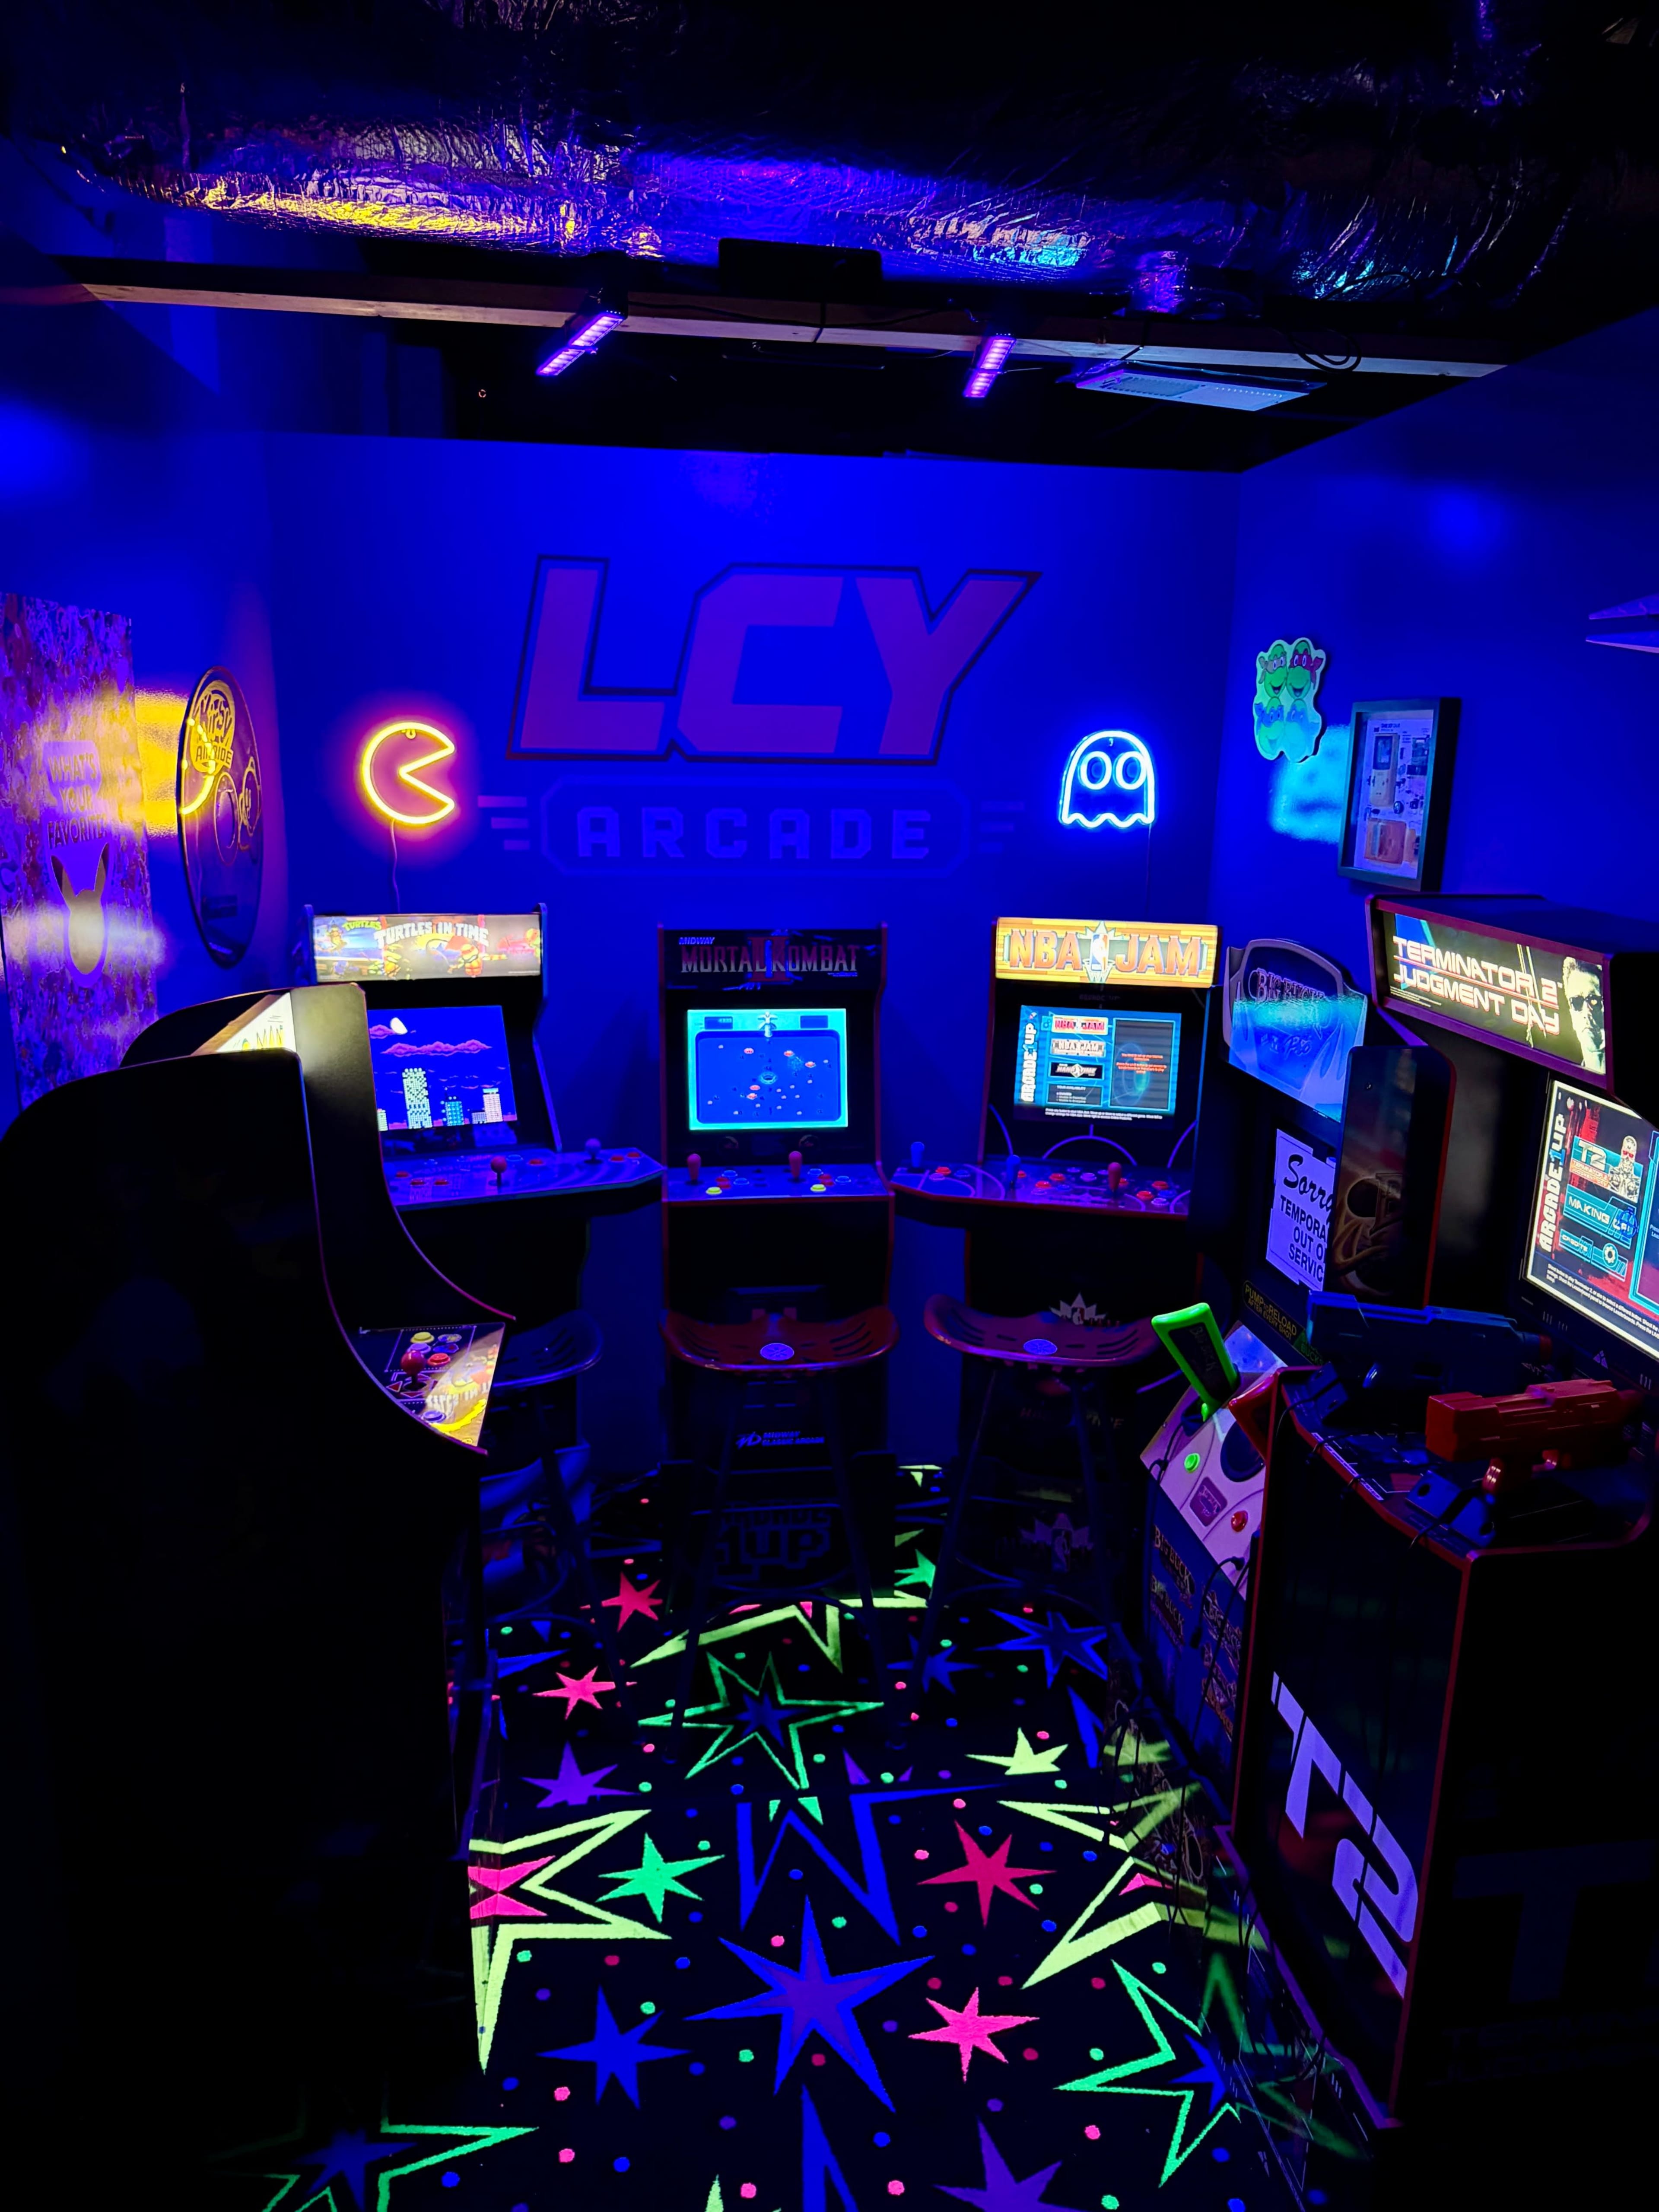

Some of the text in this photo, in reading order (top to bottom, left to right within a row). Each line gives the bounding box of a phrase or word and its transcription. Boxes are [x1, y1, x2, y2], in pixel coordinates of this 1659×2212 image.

[512, 560, 1035, 761] LCY
[48, 753, 97, 783] WHAT'S
[59, 786, 93, 811] YOUR
[47, 813, 107, 850] FAVORITE?
[577, 807, 931, 859] ARCADE
[342, 921, 382, 931] TURTLES
[373, 922, 489, 949] TURTLES IN TIME
[679, 937, 715, 945] MIDWAY
[681, 945, 861, 973] MORTAL KOMBAT
[1009, 929, 1203, 977] NBA JAM
[1256, 968, 1282, 1003] BIG
[1392, 935, 1536, 997] TERMINATOR
[1541, 978, 1558, 1005] 2
[1393, 964, 1505, 1016] JUDGMENT
[1511, 998, 1560, 1036] DAY
[1055, 1020, 1105, 1031] NBA JAM
[1579, 1139, 1607, 1171] T2
[1568, 1196, 1611, 1225] MAKING
[1294, 1226, 1314, 1253] OUT
[1245, 1284, 1264, 1305] PUMP
[1269, 1304, 1297, 1336] RELOAD
[1248, 1298, 1292, 1341] AFTER EVERY SHOT
[1271, 1671, 1418, 2000] T2
